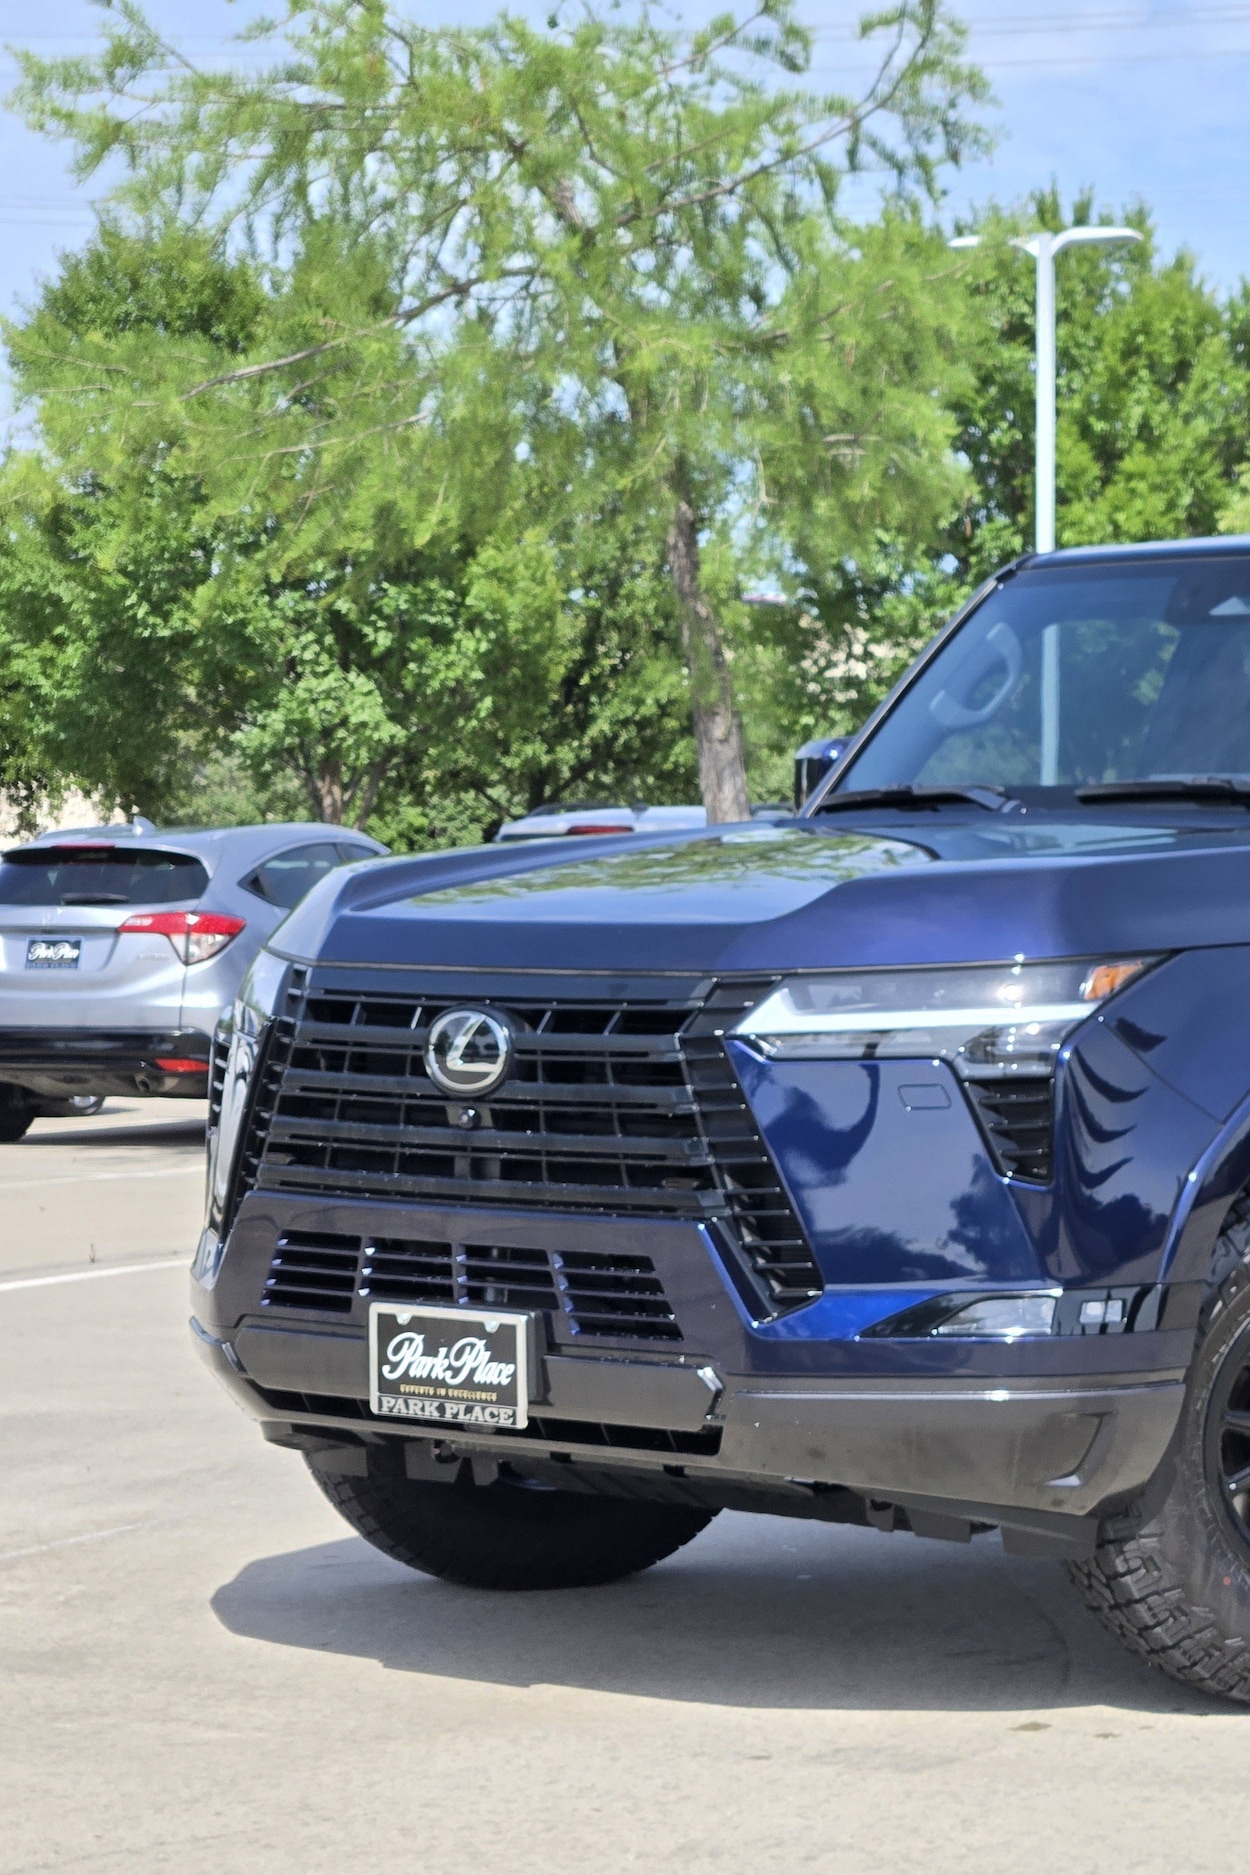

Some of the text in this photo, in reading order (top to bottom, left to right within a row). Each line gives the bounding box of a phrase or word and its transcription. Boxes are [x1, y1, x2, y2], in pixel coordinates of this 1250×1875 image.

[382, 1332, 515, 1385] Park Place
[381, 1397, 513, 1425] PARK PLACE
